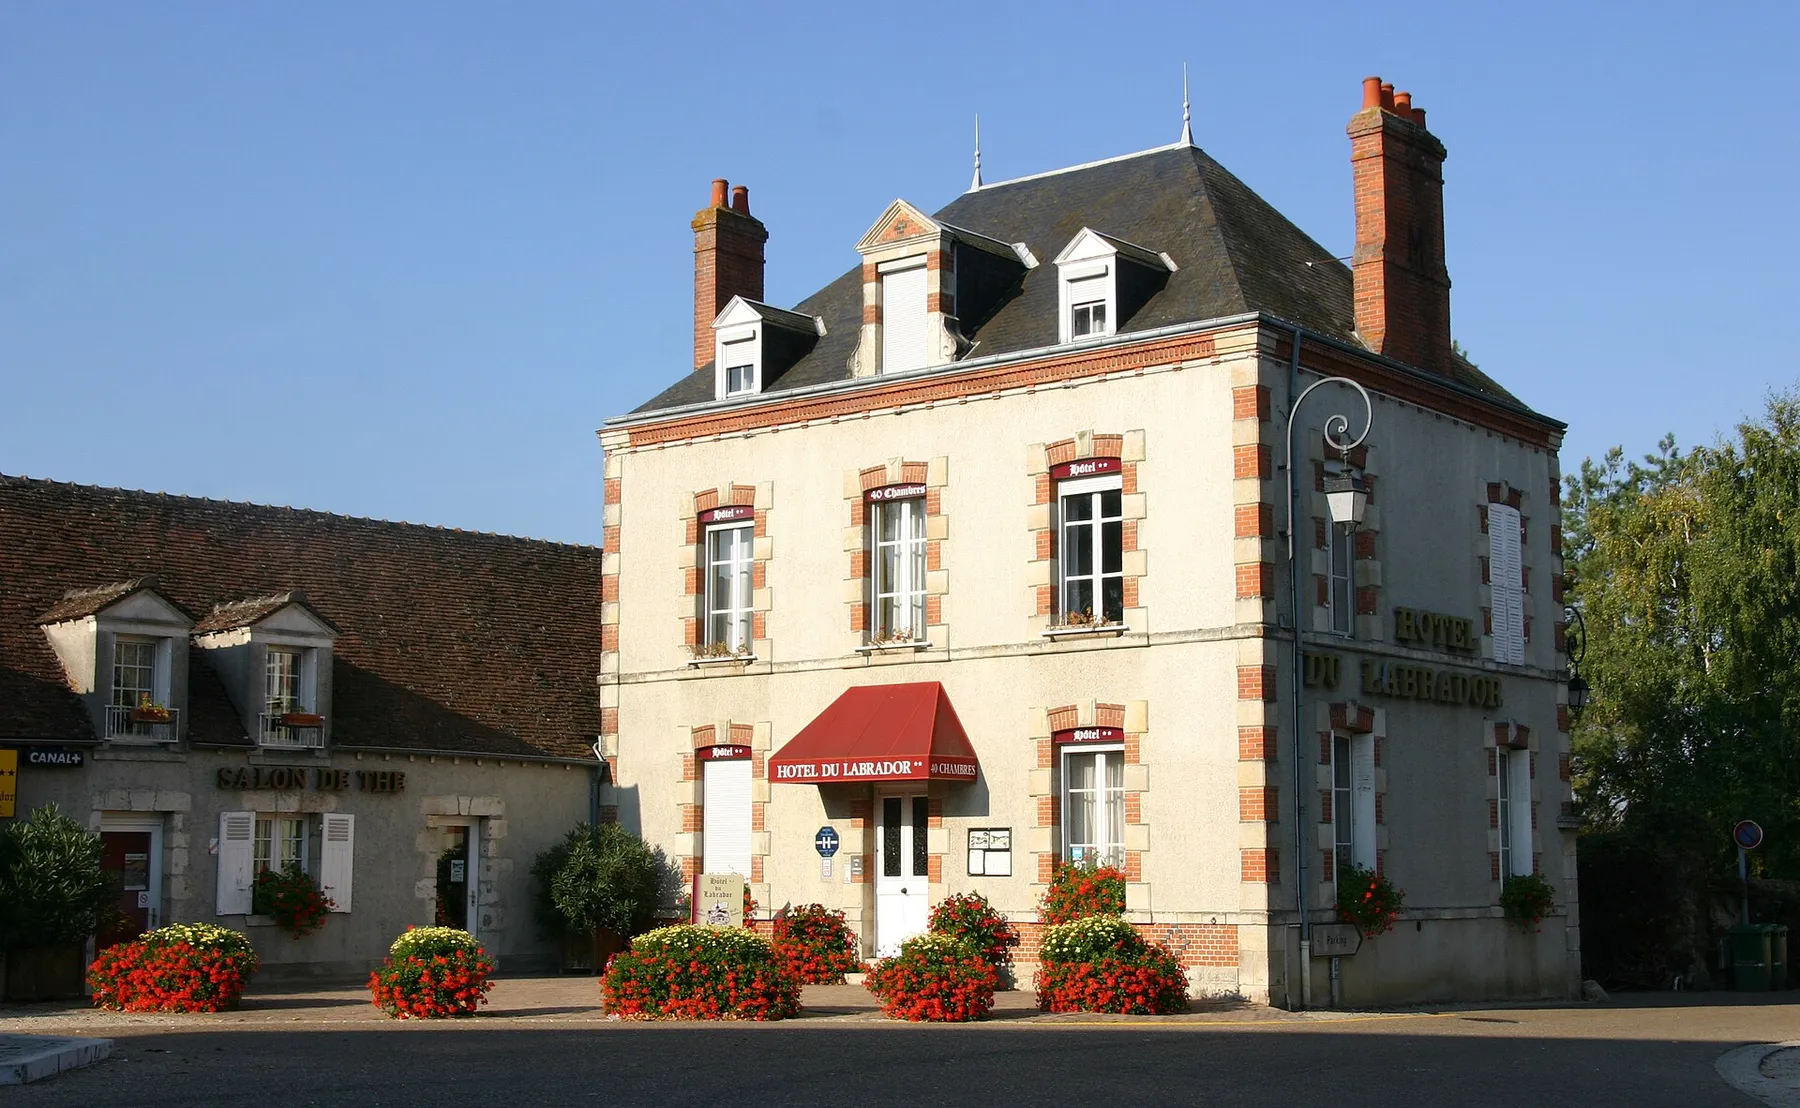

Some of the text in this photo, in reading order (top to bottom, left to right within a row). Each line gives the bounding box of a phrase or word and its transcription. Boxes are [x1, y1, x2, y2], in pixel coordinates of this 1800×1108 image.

[1069, 462, 1096, 476] Hôtel
[870, 485, 926, 499] 40 Chambres
[1395, 606, 1481, 651] HOTEL
[1303, 651, 1503, 708] DU LABRADOR
[1073, 729, 1100, 741] Hôtel
[30, 752, 81, 764] CANAL+
[776, 760, 912, 778] HOTEL DU LABRADOR
[930, 763, 976, 776] 40 CHAMBRES
[217, 766, 405, 793] SALON DE THE
[822, 836, 831, 849] H
